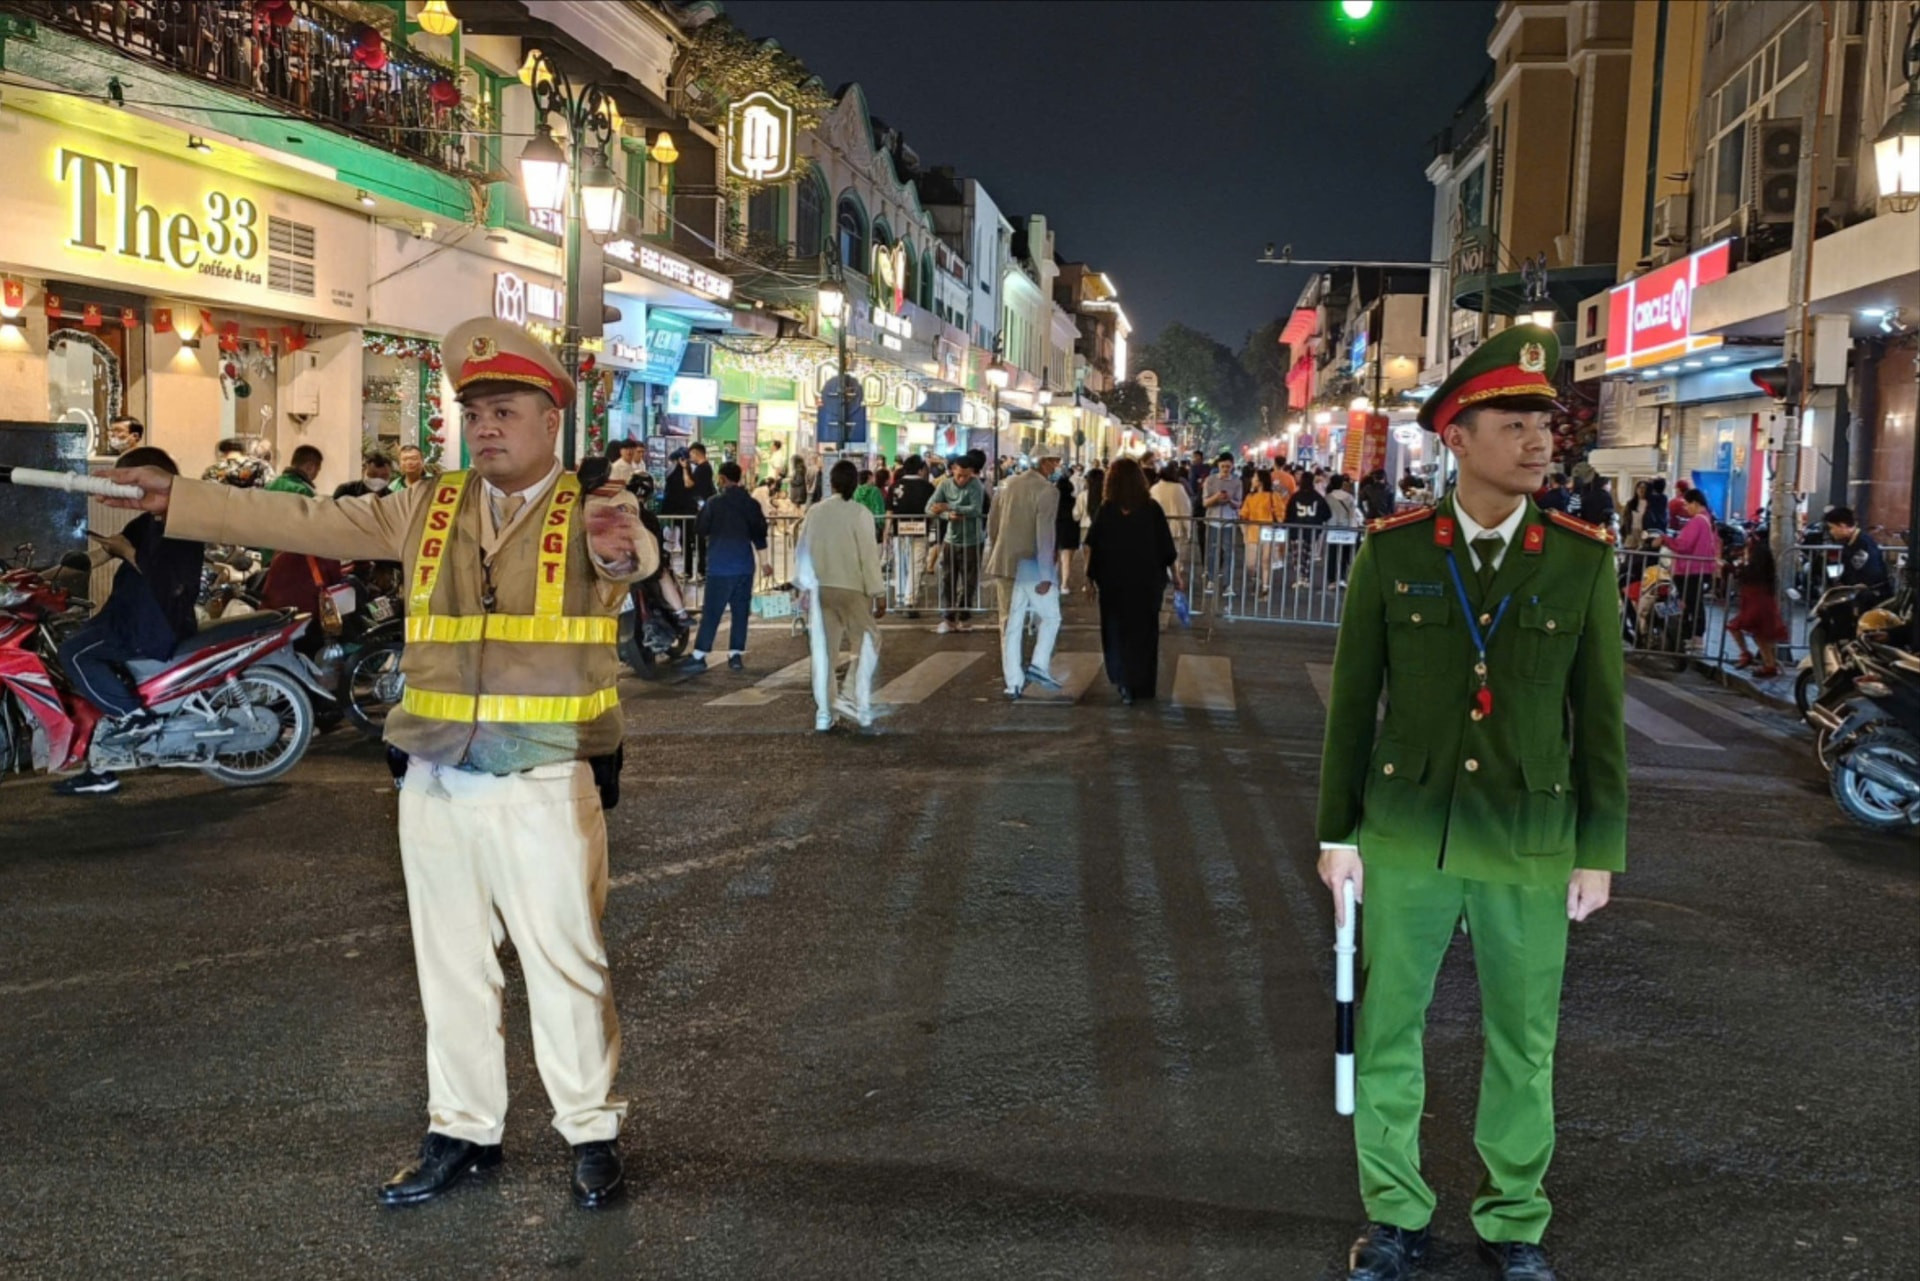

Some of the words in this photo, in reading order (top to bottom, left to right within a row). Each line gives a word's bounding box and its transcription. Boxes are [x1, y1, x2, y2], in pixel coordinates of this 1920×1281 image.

[60, 148, 200, 268] The
[206, 191, 259, 260] 33
[198, 259, 232, 279] coffee
[233, 264, 243, 281] &
[244, 270, 262, 285] tea
[1635, 293, 1670, 330] CIRCLE
[1671, 278, 1688, 330] K
[420, 487, 458, 587] CSGT
[543, 491, 576, 584] CSGT
